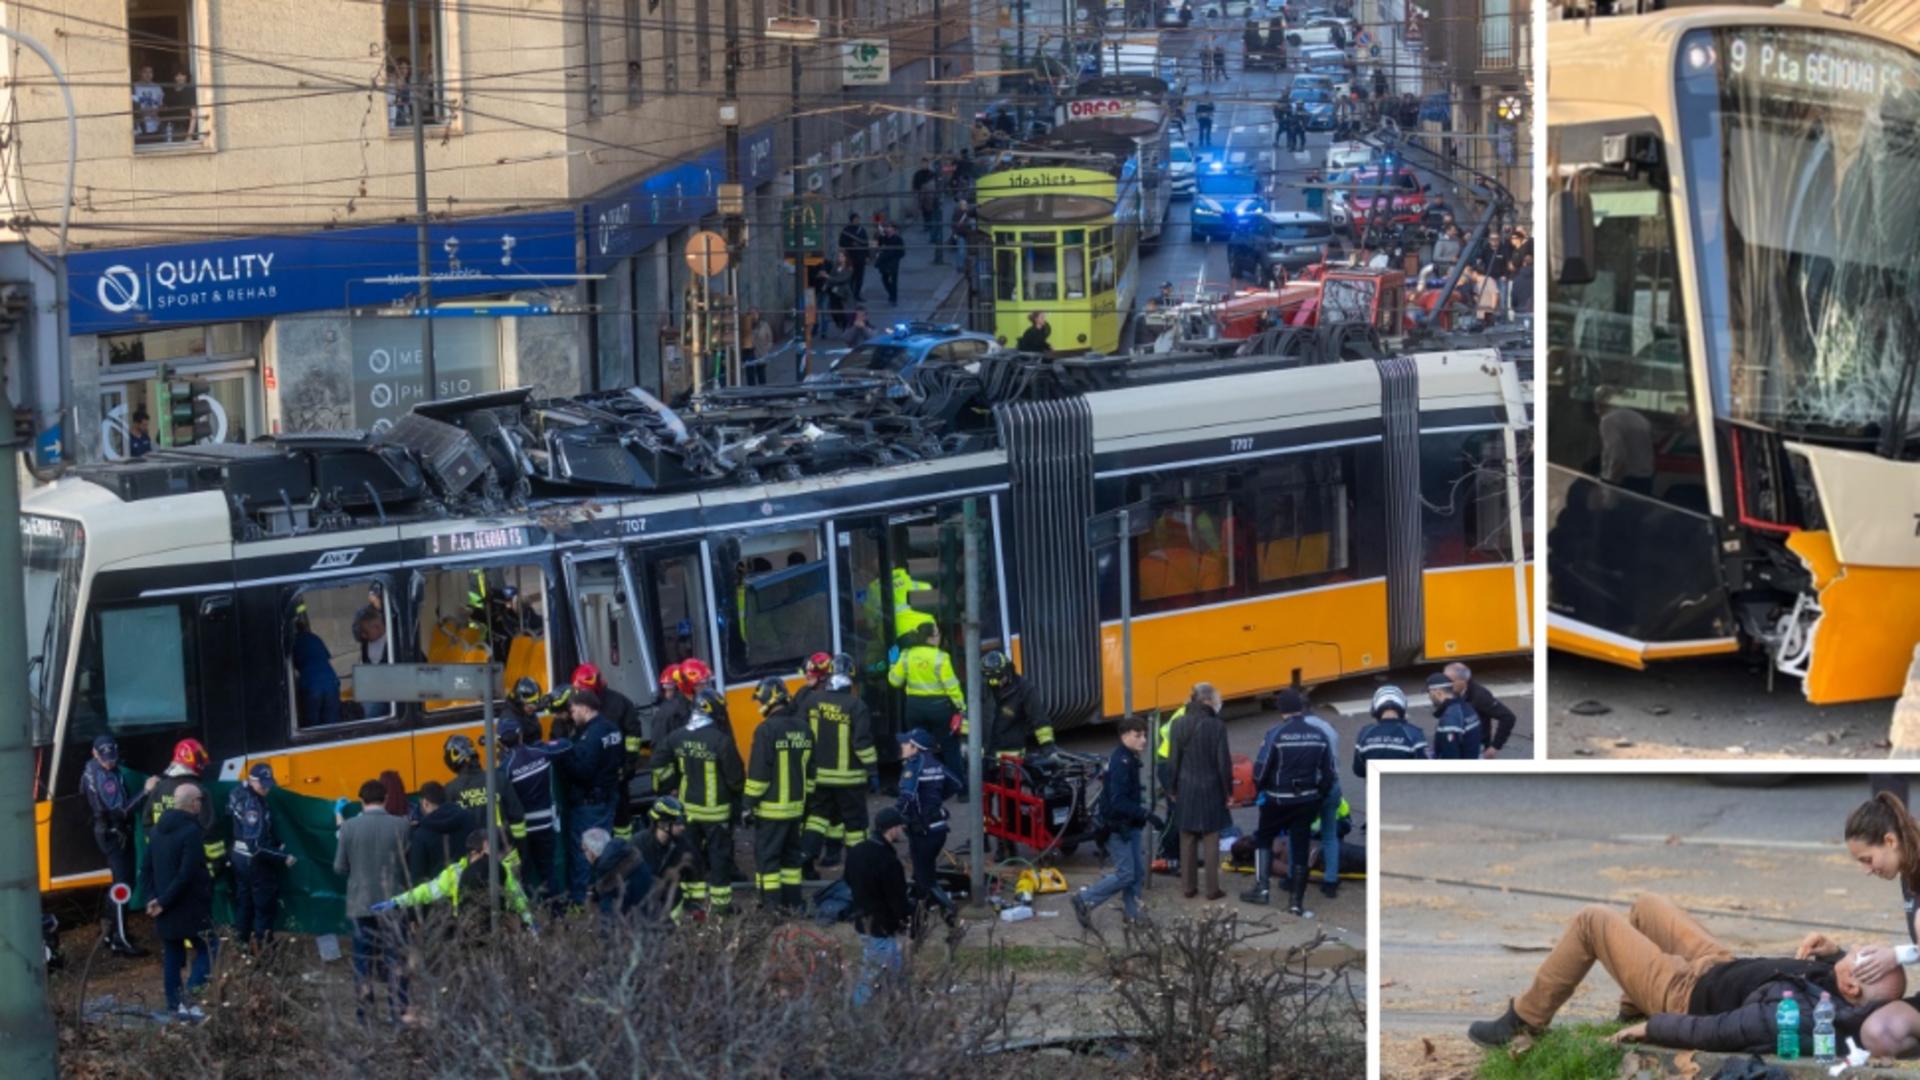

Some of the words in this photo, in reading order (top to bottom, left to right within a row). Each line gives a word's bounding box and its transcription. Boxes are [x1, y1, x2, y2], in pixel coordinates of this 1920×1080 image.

[1731, 39, 1747, 73] 9
[1760, 44, 1800, 82] P.ta
[1805, 53, 1875, 93] GENOVA
[156, 252, 275, 290] QUALITY
[158, 292, 207, 308] SPORT
[212, 290, 222, 302] &
[227, 286, 278, 303] REHAB
[401, 379, 471, 399] PHSIO
